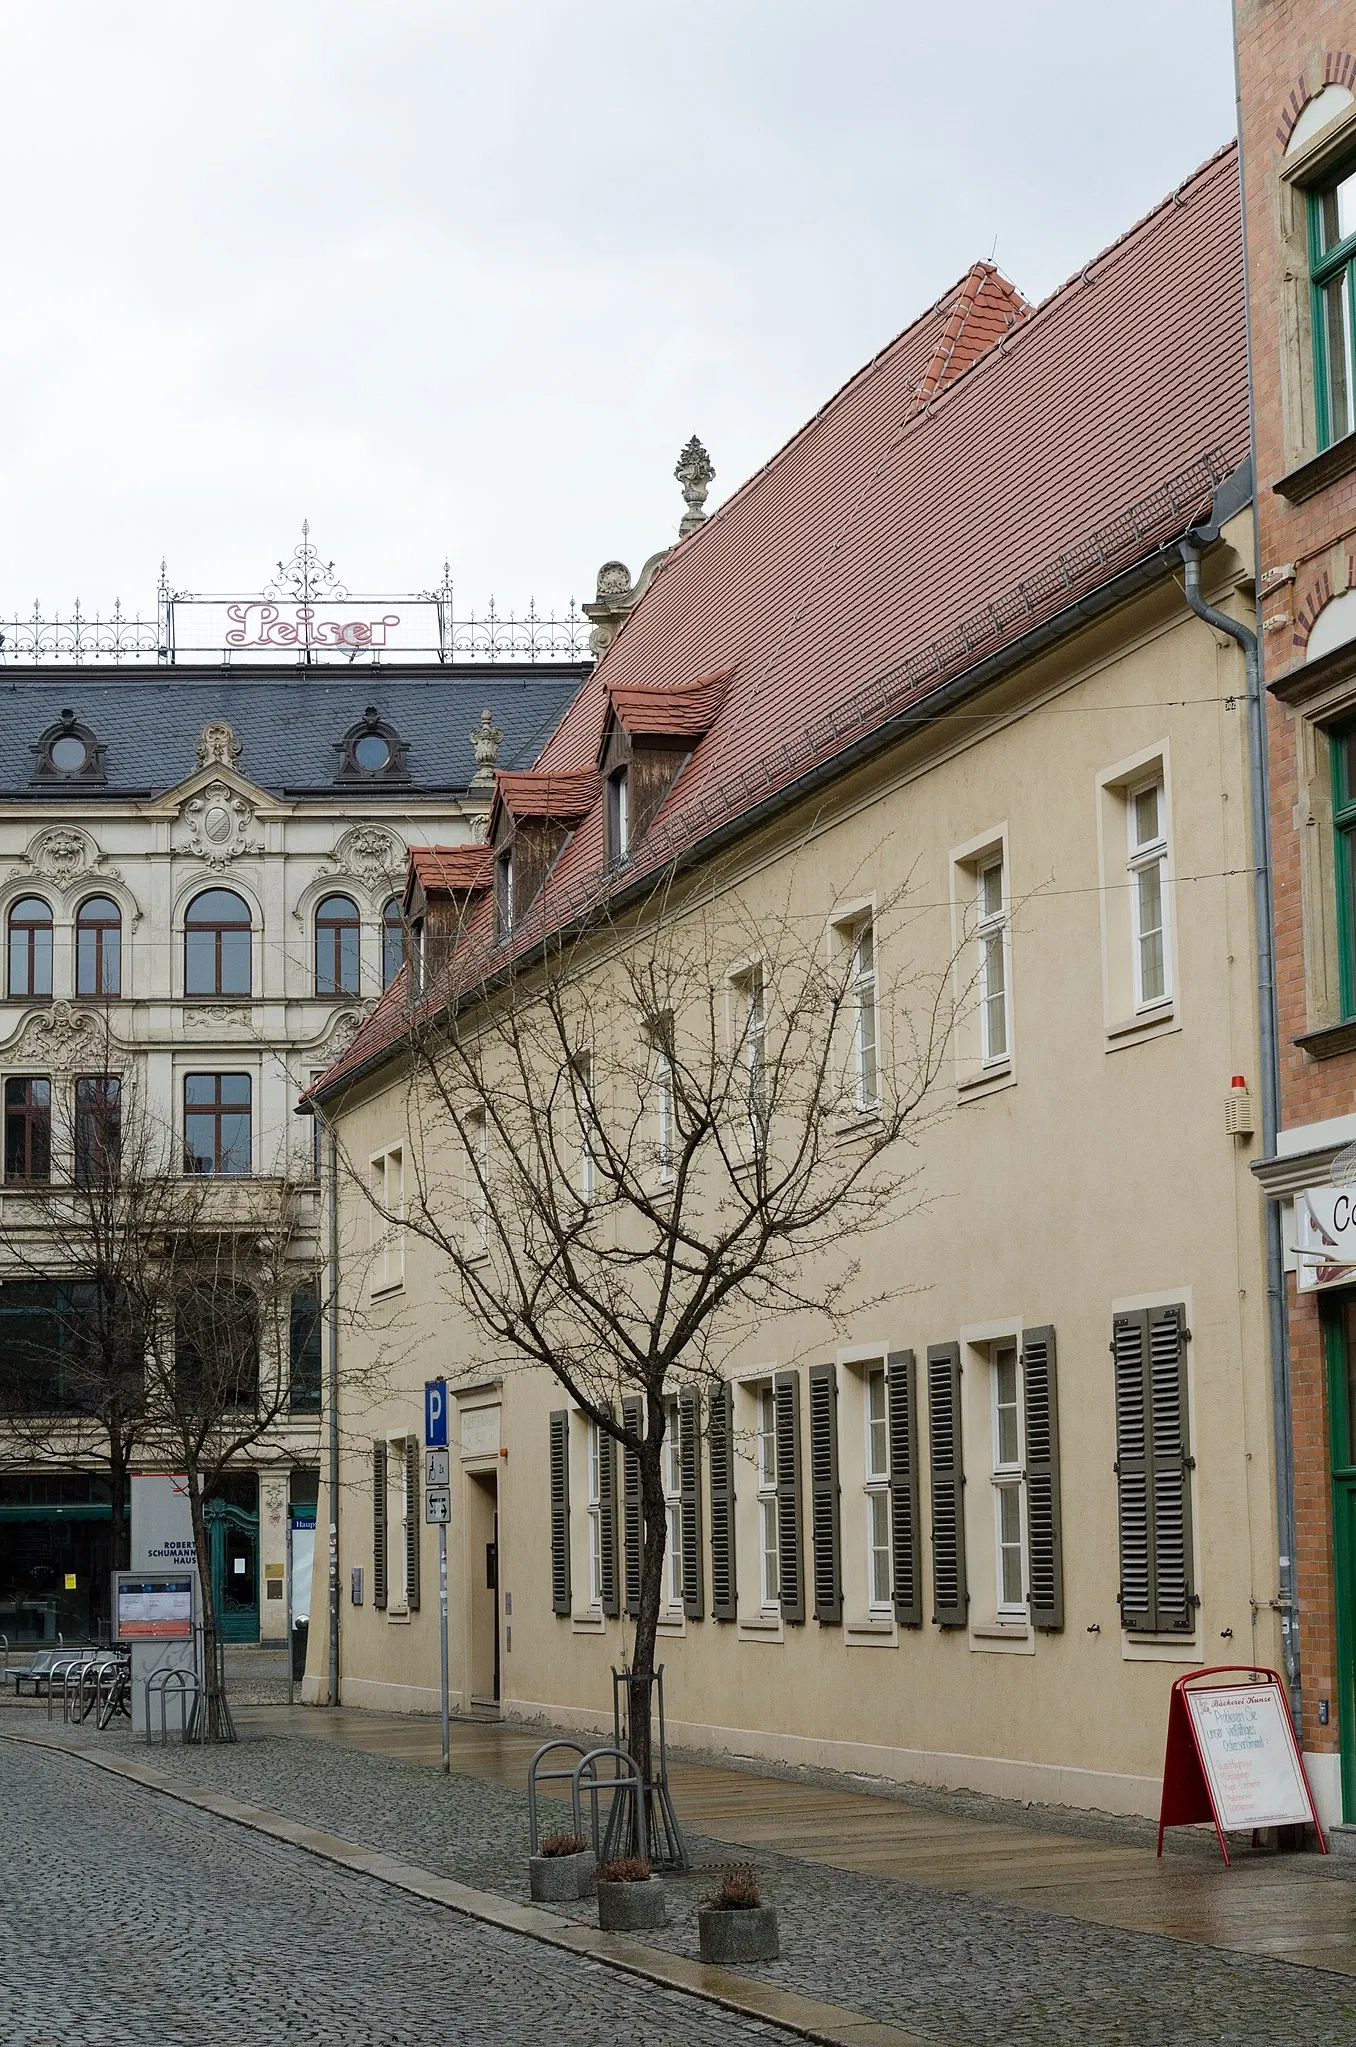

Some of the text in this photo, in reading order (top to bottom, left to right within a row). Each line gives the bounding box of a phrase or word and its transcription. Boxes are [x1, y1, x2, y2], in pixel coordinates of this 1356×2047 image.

[226, 604, 400, 647] Leiser
[430, 1389, 442, 1438] P
[164, 1541, 197, 1549] ROBERT
[147, 1549, 197, 1557] SCHUMANN
[173, 1556, 197, 1564] HAUS
[1246, 1695, 1271, 1705] Kunze
[1245, 1706, 1258, 1721] Sie
